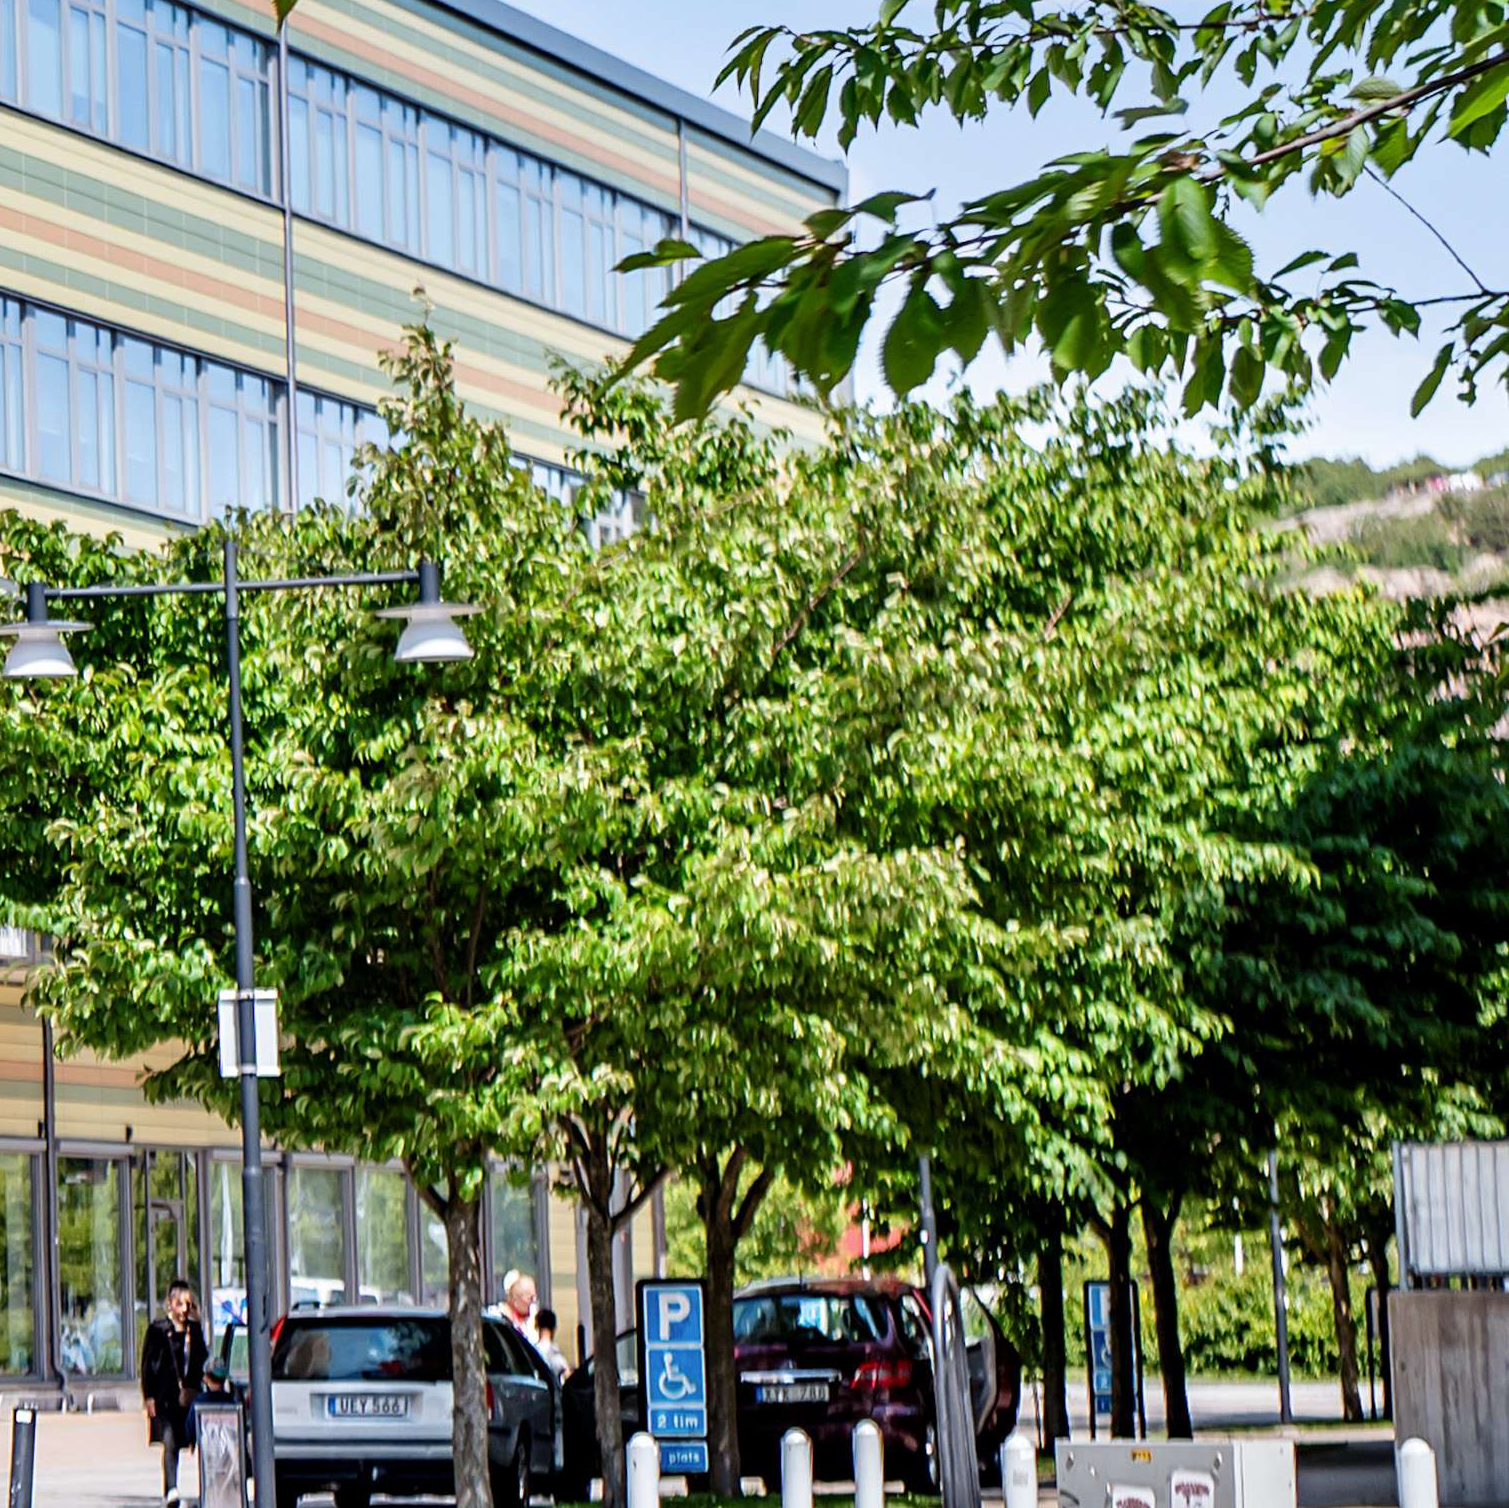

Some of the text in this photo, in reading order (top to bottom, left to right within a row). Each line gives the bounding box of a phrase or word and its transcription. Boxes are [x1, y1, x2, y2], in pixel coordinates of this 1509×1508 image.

[658, 1293, 691, 1341] P
[340, 1396, 401, 1414] UEY 566
[657, 1413, 699, 1429] 2 tim
